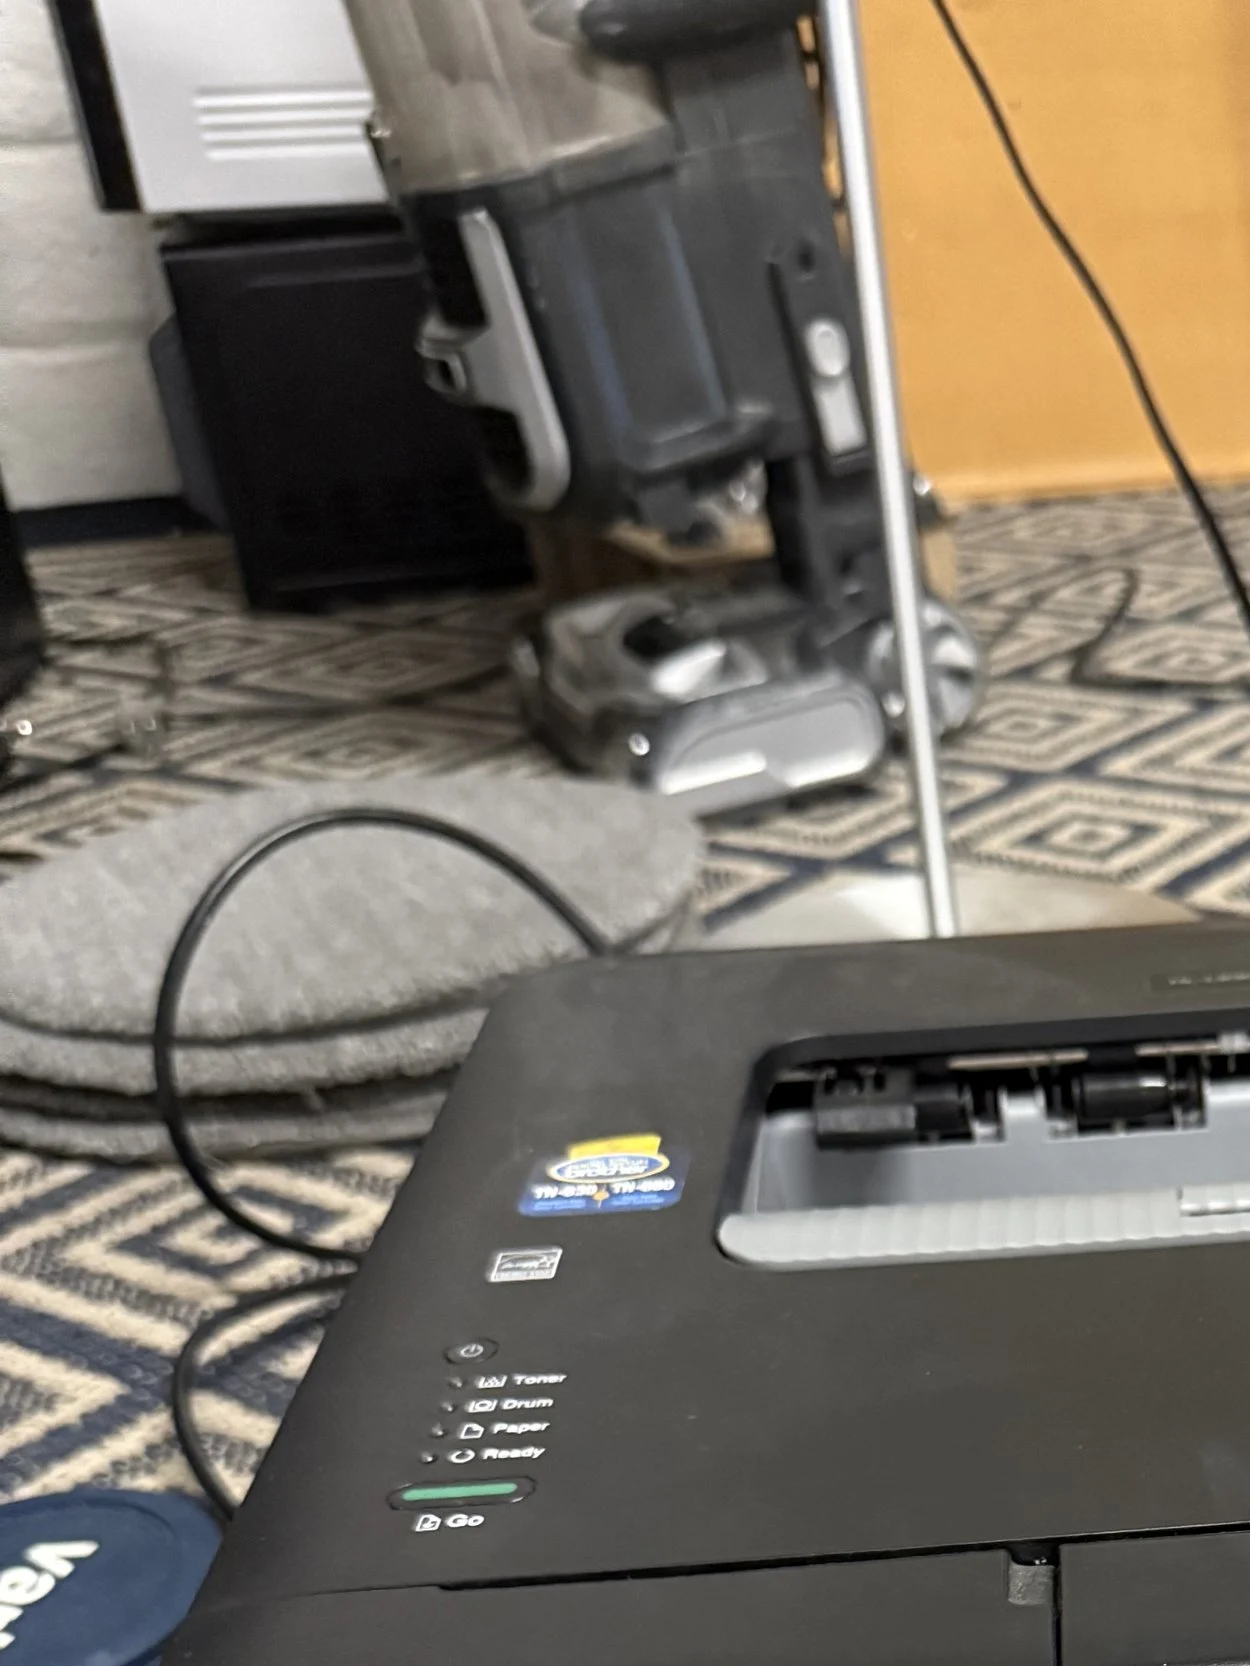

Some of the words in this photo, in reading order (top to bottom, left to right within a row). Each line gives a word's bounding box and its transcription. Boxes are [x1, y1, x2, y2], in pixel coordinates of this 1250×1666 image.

[514, 1374, 567, 1386] Toner
[502, 1398, 554, 1410] Drum
[492, 1422, 550, 1435] Paper
[483, 1446, 546, 1460] Ready
[446, 1514, 485, 1528] Go
